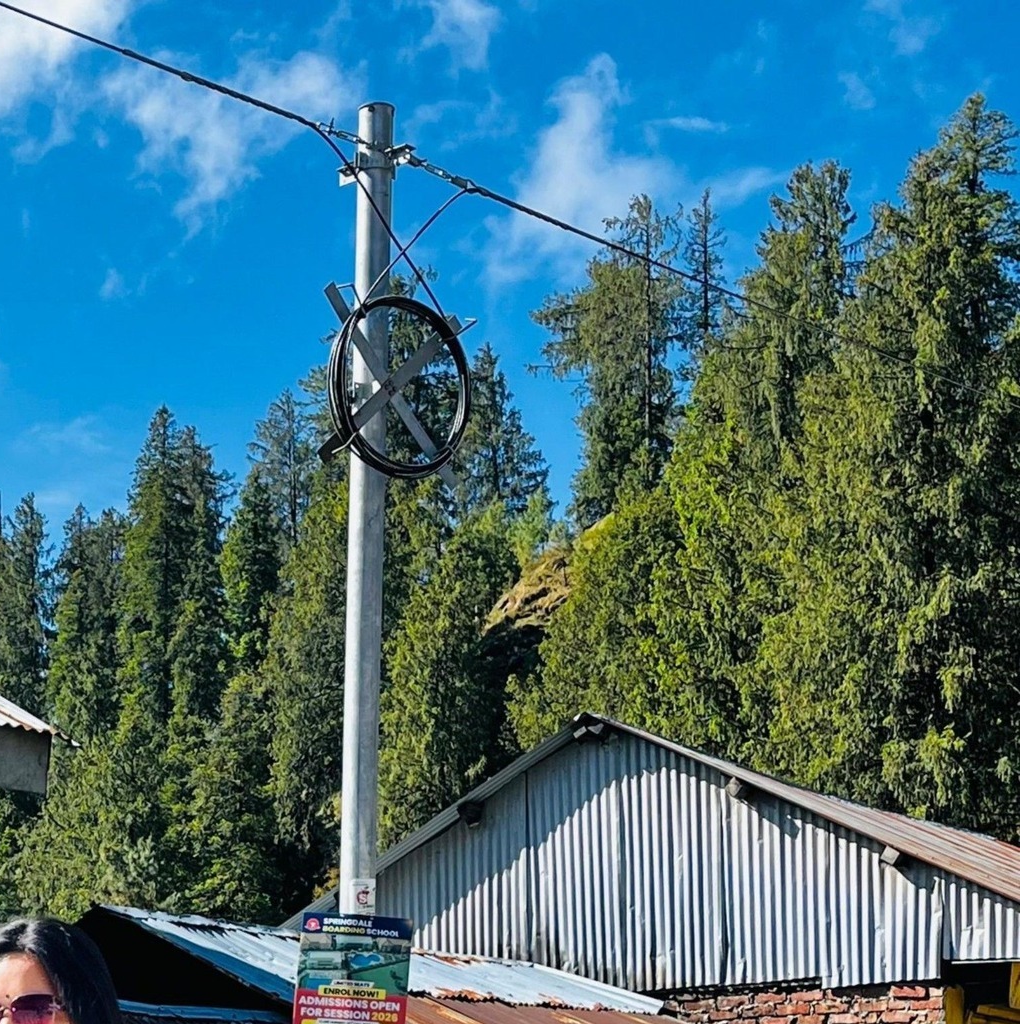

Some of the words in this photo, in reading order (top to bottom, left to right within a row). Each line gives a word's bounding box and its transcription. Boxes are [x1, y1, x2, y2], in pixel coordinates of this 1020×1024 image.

[323, 917, 373, 927] SPRINGDALE
[322, 925, 365, 934] BOARDING
[366, 928, 399, 938] SCHOOL
[323, 987, 351, 996] ENROL
[353, 989, 379, 998] NOW!
[298, 995, 368, 1010] ADMISSIONS
[369, 1000, 400, 1012] OPEN
[300, 1007, 323, 1017] FOR
[323, 1008, 370, 1020] SESSION
[371, 1011, 398, 1022] 2026
